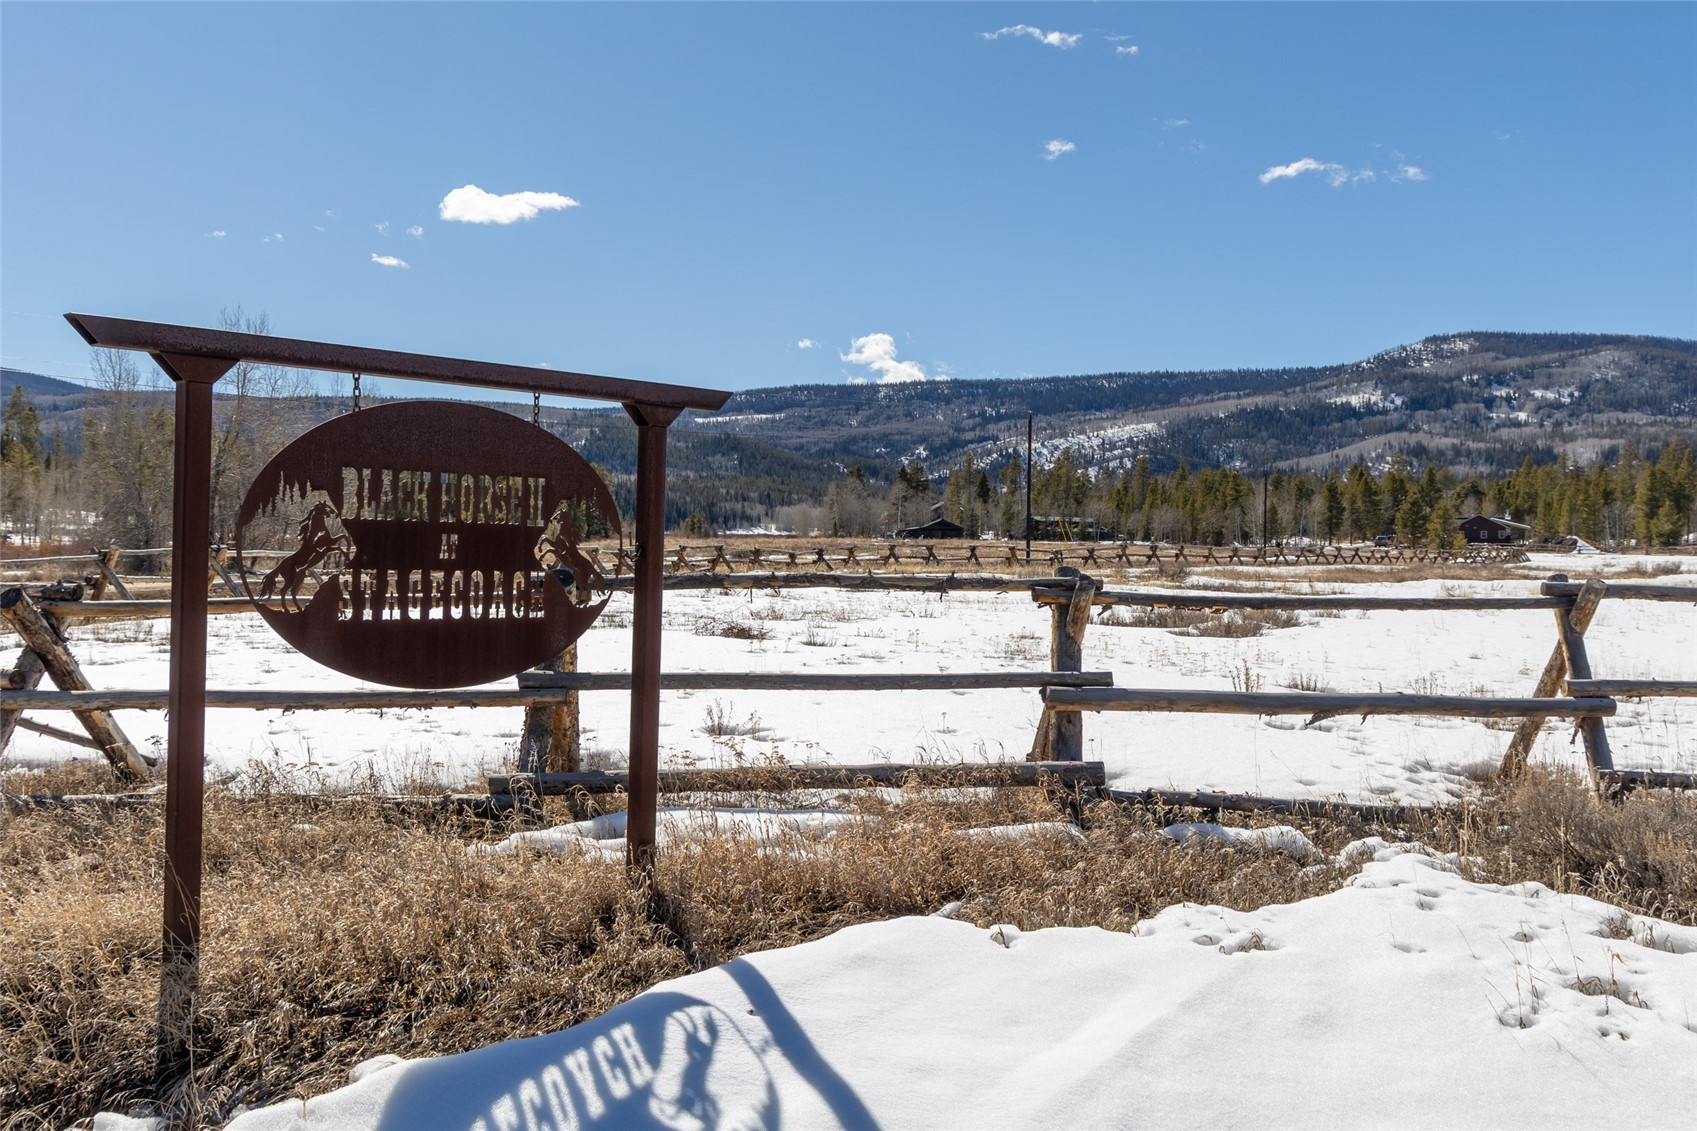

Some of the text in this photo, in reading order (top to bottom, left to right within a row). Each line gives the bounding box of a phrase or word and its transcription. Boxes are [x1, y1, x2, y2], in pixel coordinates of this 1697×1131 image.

[341, 467, 546, 527] BLACK HORSE II
[439, 533, 458, 559] AT
[338, 568, 546, 620] STAGECOACH
